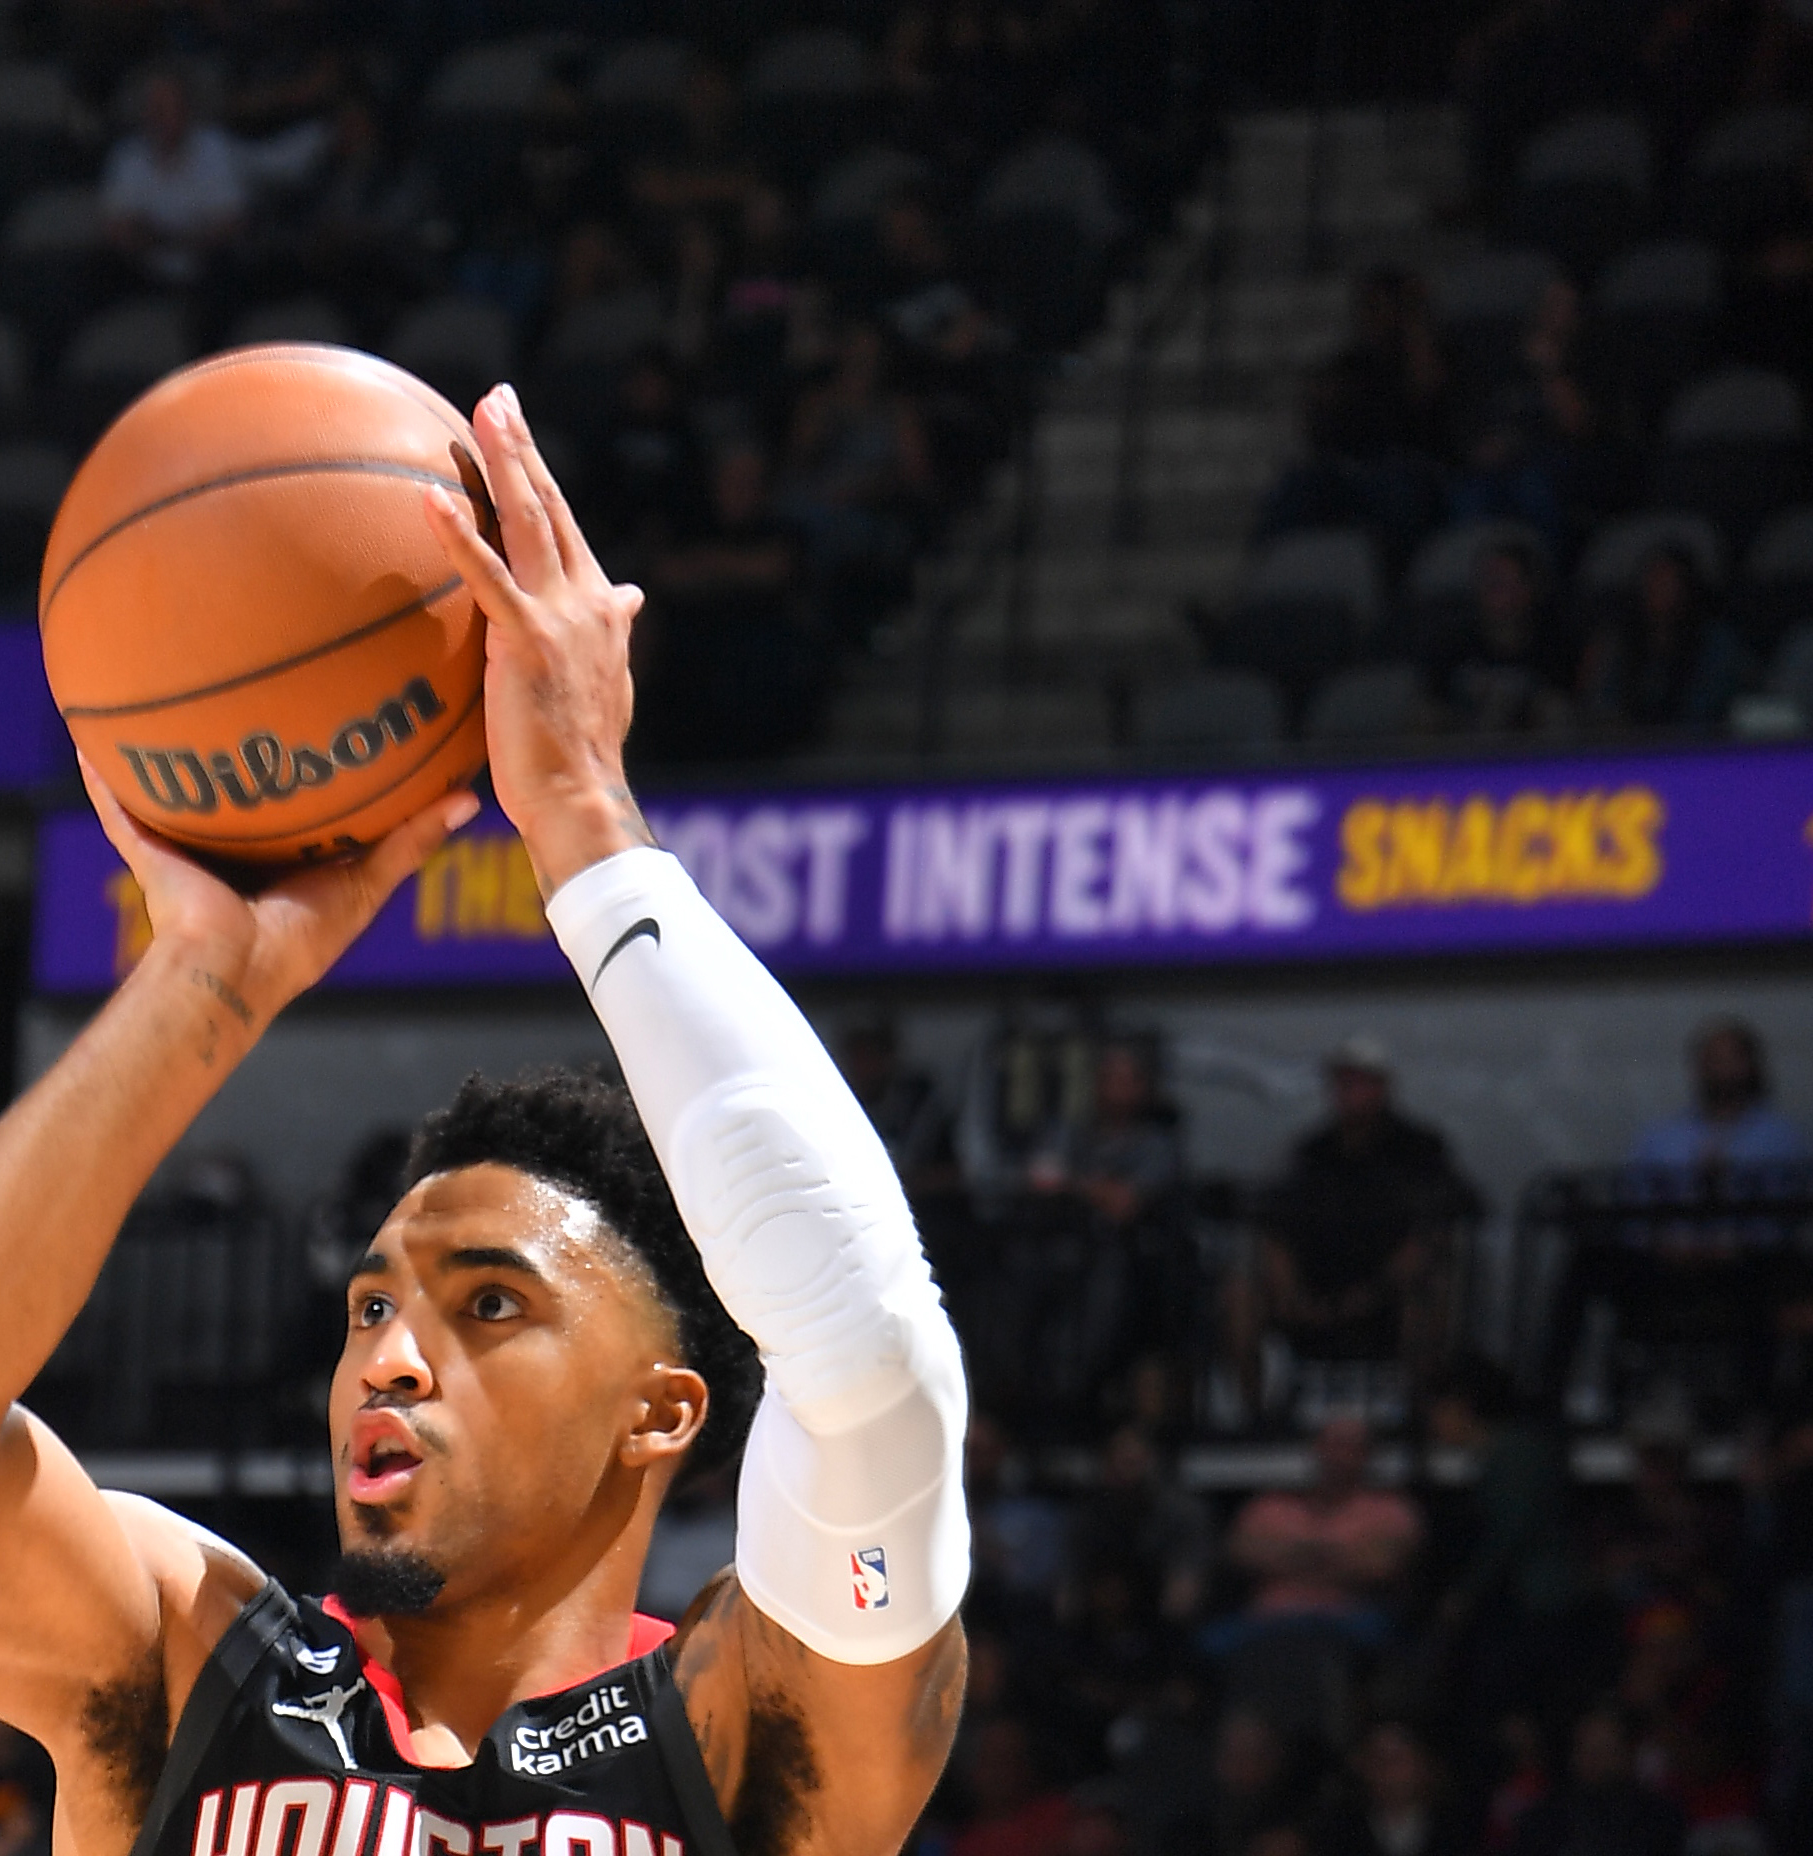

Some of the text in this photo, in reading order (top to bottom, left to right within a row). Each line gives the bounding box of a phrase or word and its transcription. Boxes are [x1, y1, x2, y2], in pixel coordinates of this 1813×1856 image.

[116, 676, 446, 814] Wilson
[882, 792, 1318, 942] INTENSE
[1336, 786, 1666, 912] SNACKS
[510, 1714, 648, 1776] karma
[515, 1684, 629, 1750] credit
